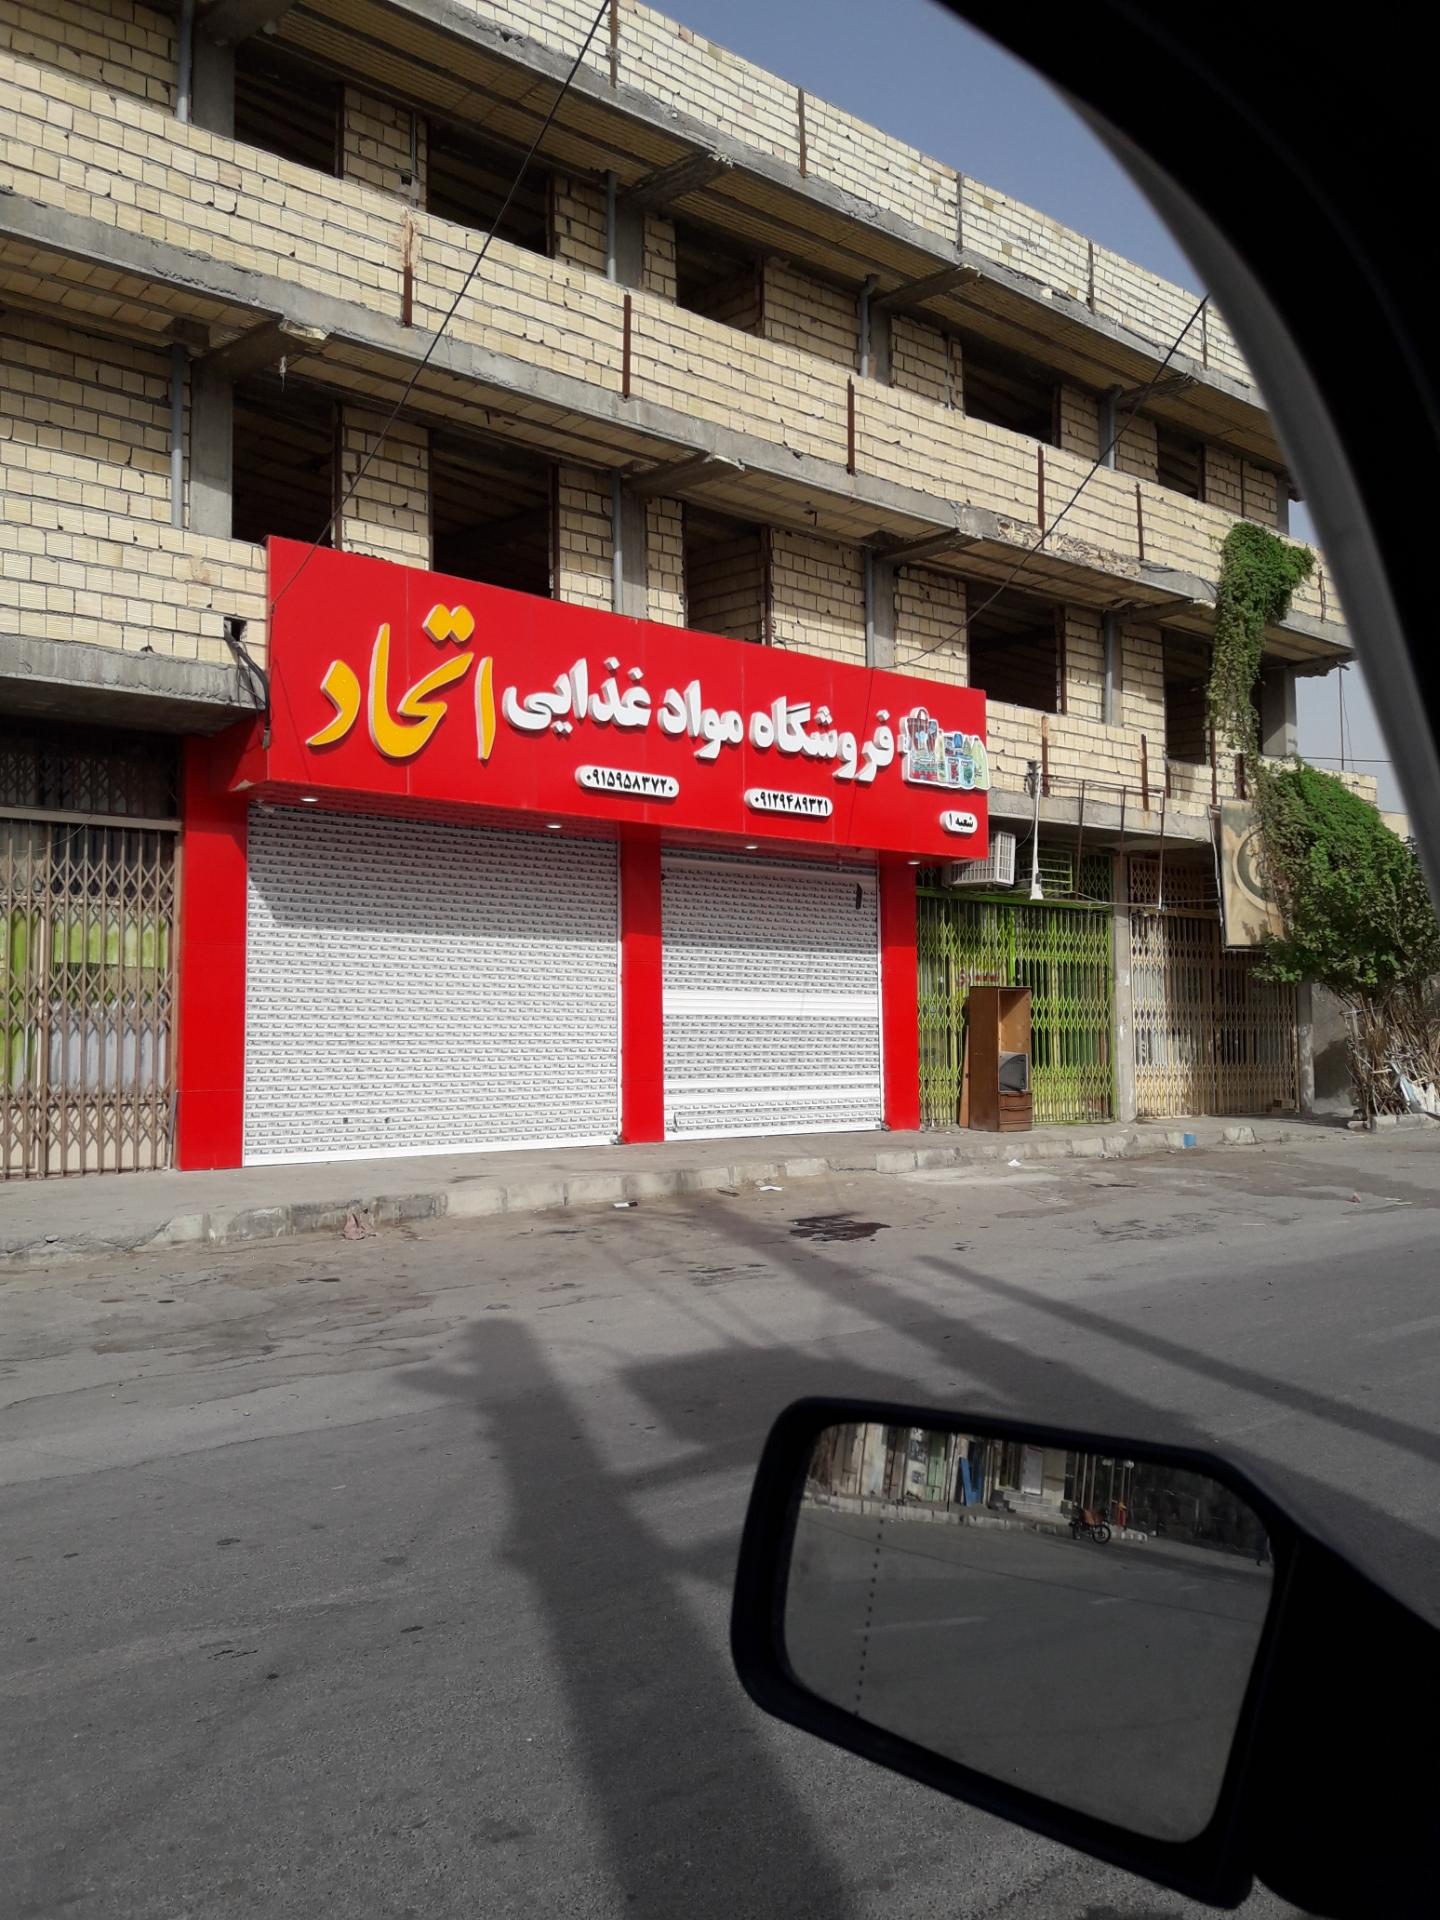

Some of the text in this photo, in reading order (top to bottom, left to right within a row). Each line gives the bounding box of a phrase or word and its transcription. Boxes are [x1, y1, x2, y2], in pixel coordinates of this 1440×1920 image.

[305, 603, 496, 761] اتحاد
[502, 656, 651, 734] غذایی
[657, 680, 743, 760] مواد
[749, 696, 895, 782] فروشگاه
[955, 815, 974, 831] شعبه
